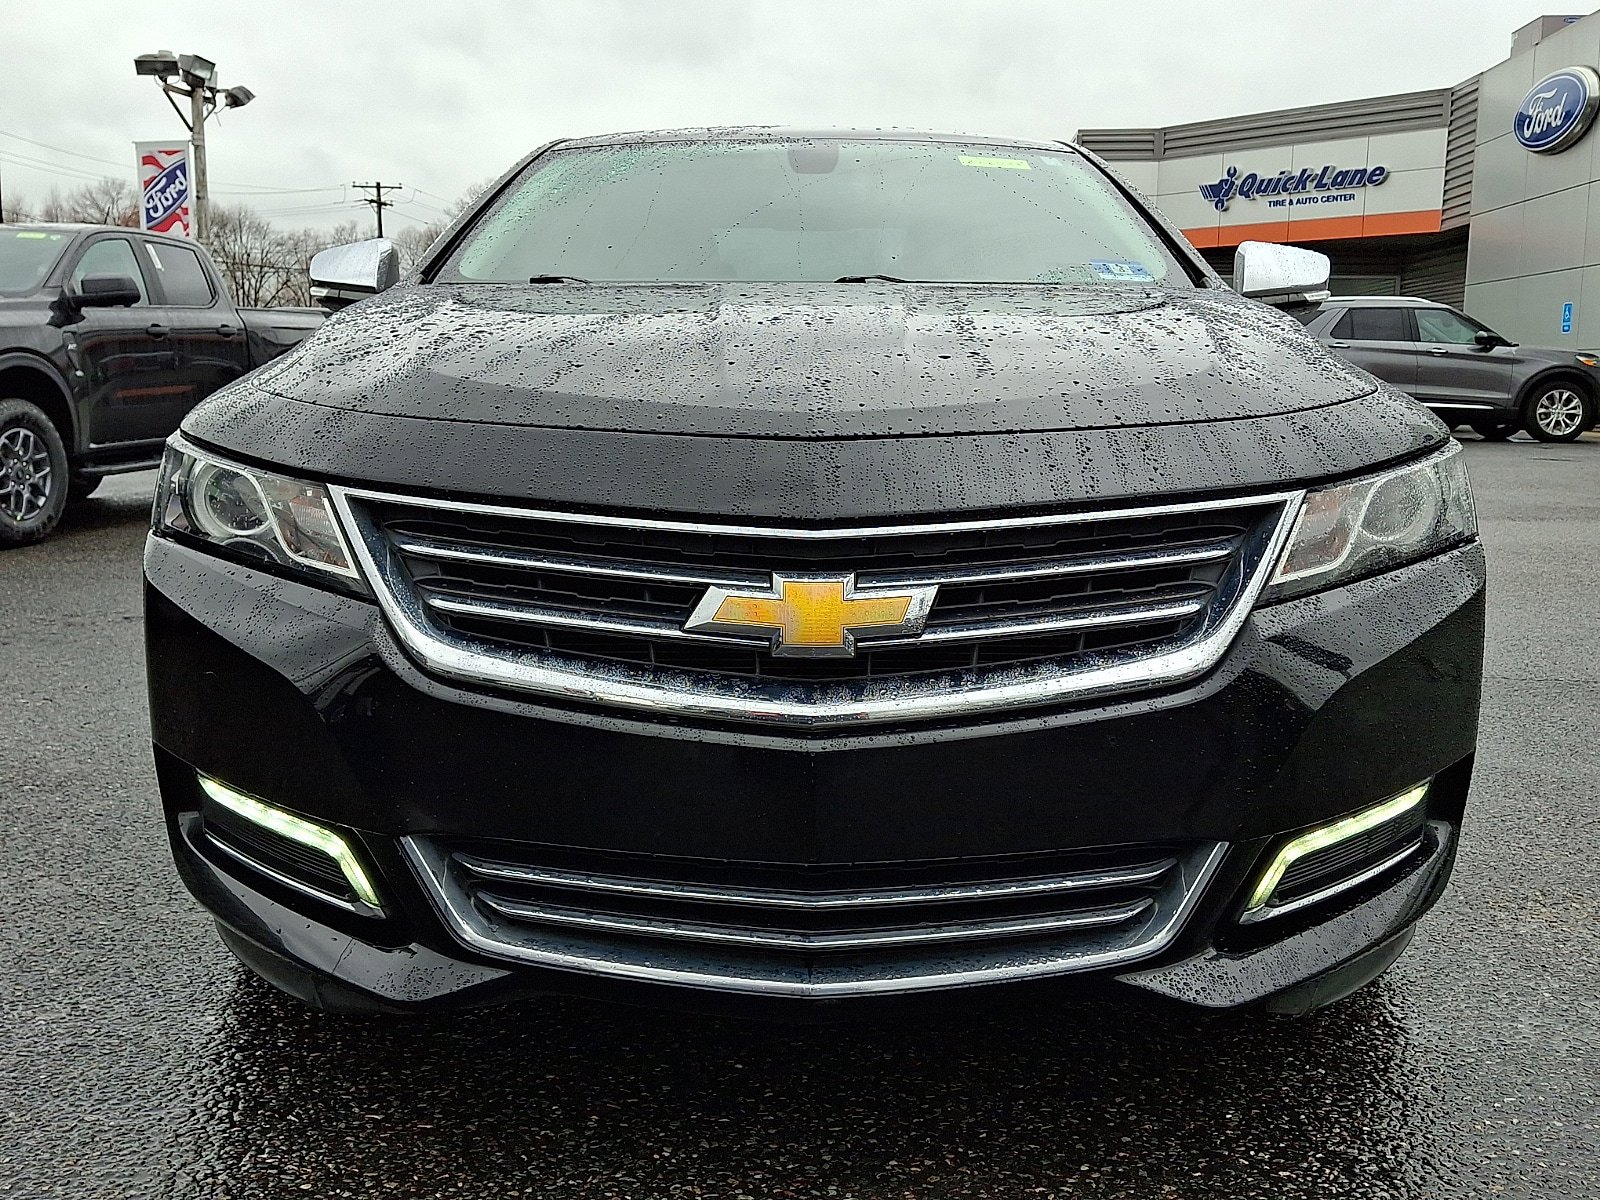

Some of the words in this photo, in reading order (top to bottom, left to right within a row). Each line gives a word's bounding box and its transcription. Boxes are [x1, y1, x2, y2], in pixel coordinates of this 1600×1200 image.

[1523, 88, 1568, 138] Ford
[145, 169, 187, 218] Ford
[1238, 167, 1314, 199] Quick
[1314, 165, 1388, 191] Lane
[1267, 198, 1287, 208] TIRE
[1295, 196, 1319, 206] AUTO
[1320, 193, 1356, 203] CENTER
